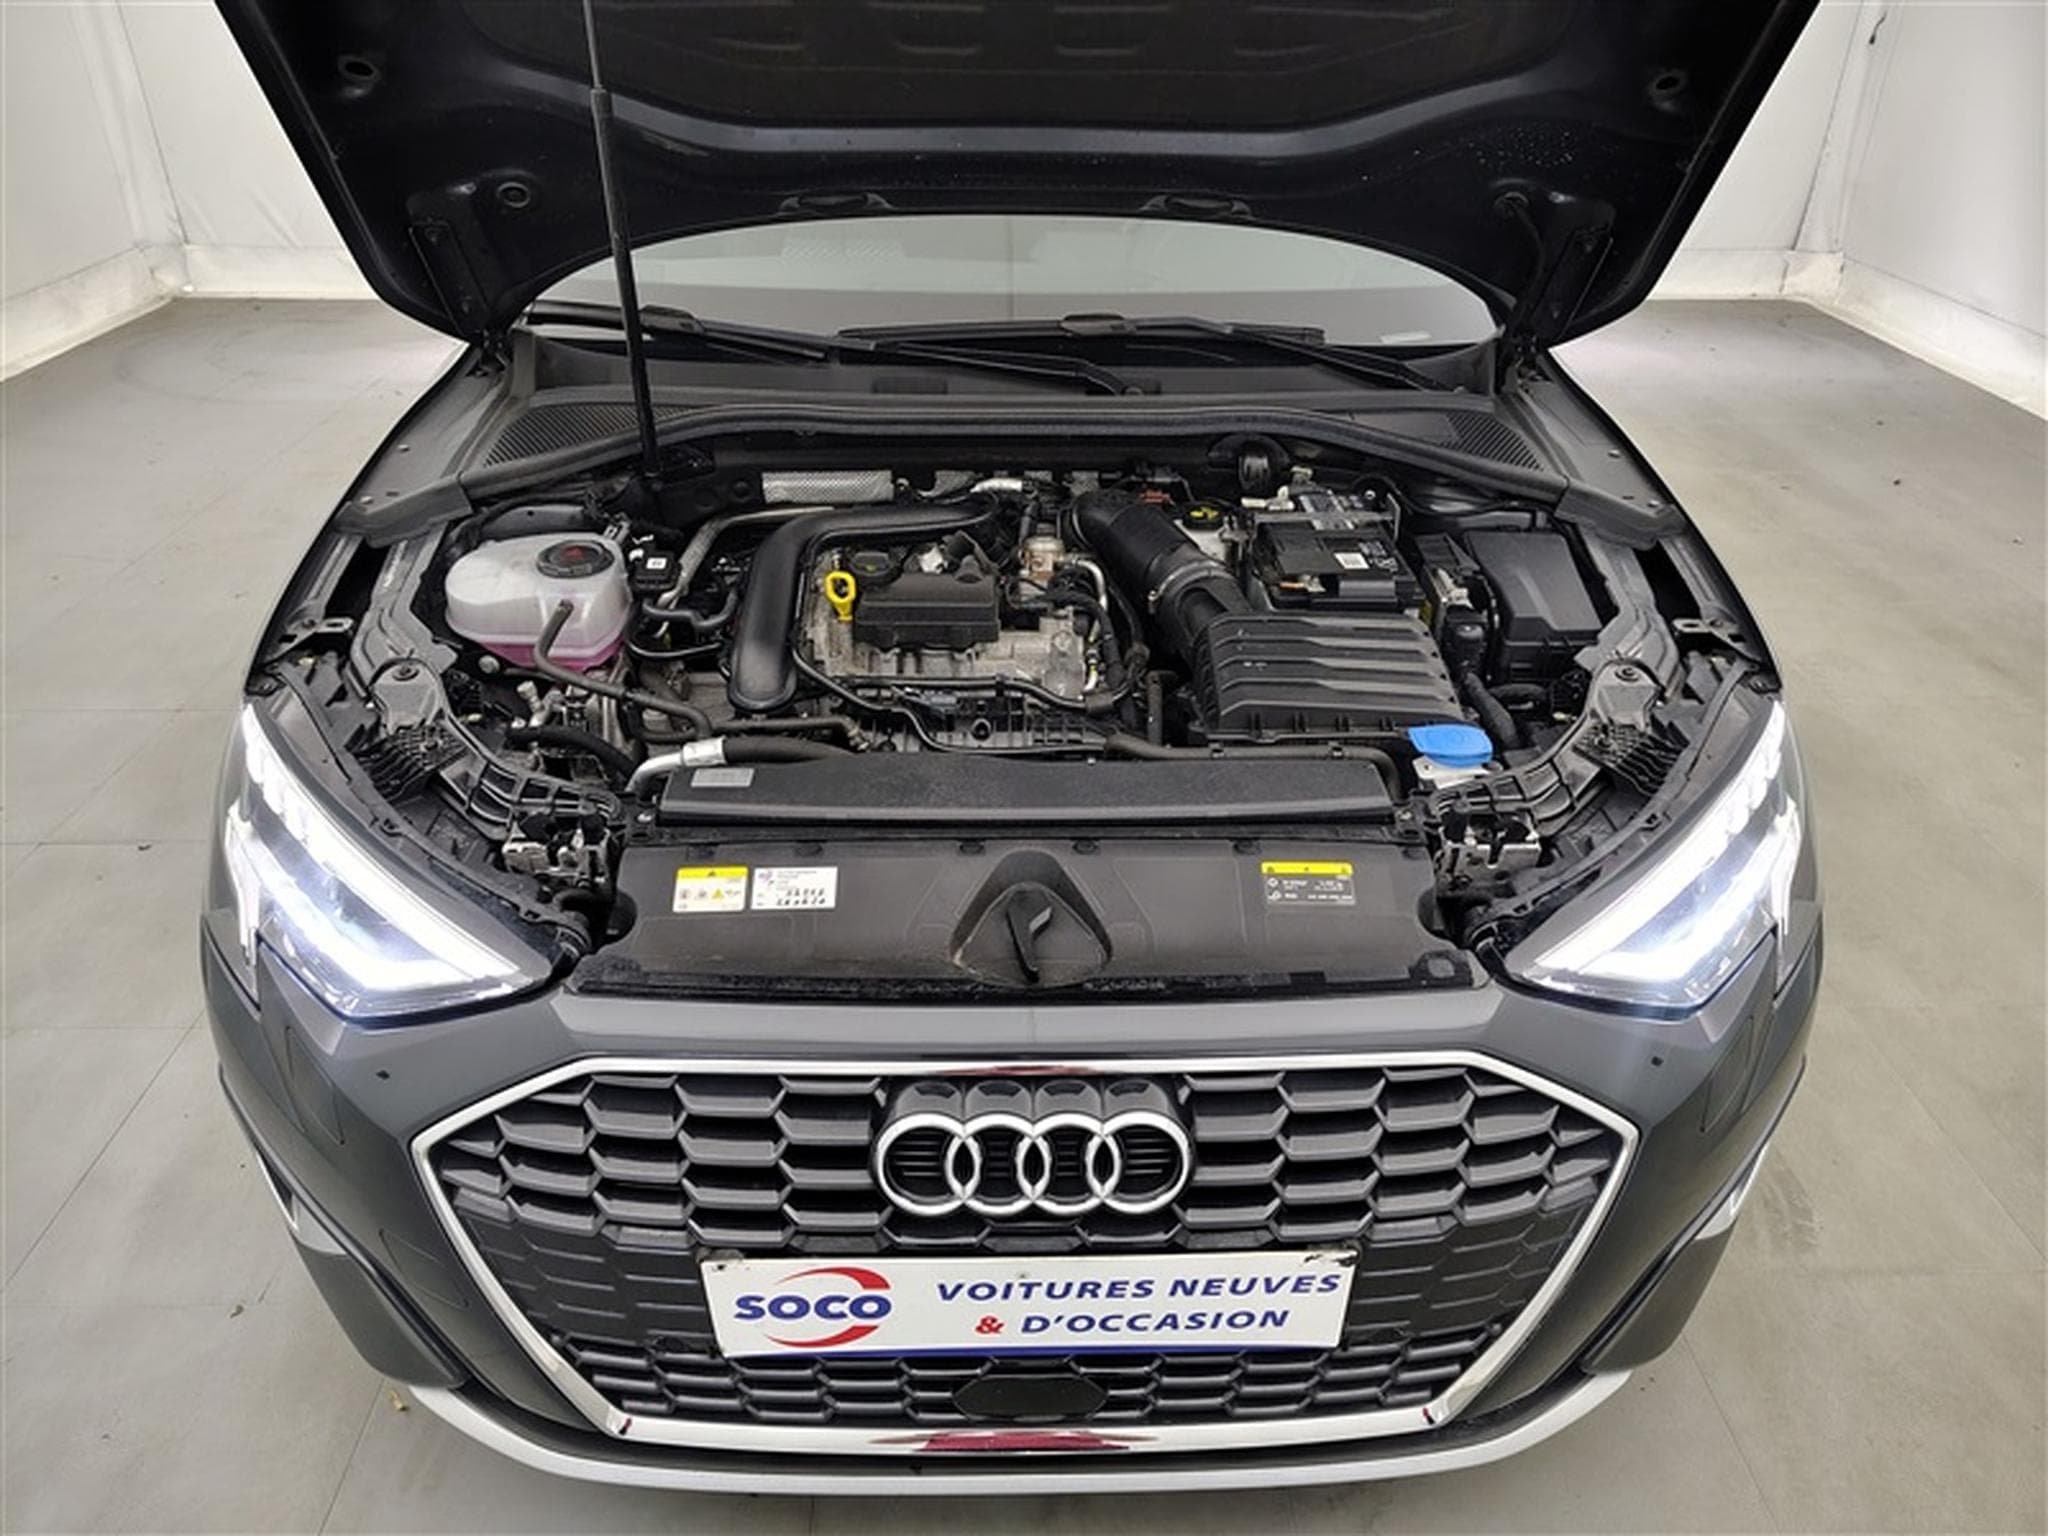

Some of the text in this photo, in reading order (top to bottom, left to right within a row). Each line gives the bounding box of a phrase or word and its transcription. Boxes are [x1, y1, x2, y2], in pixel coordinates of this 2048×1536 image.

[937, 1274, 1341, 1301] VOITURES NEUVES
[734, 1295, 892, 1320] SOCO
[975, 1310, 1290, 1334] & D'OCCASION
